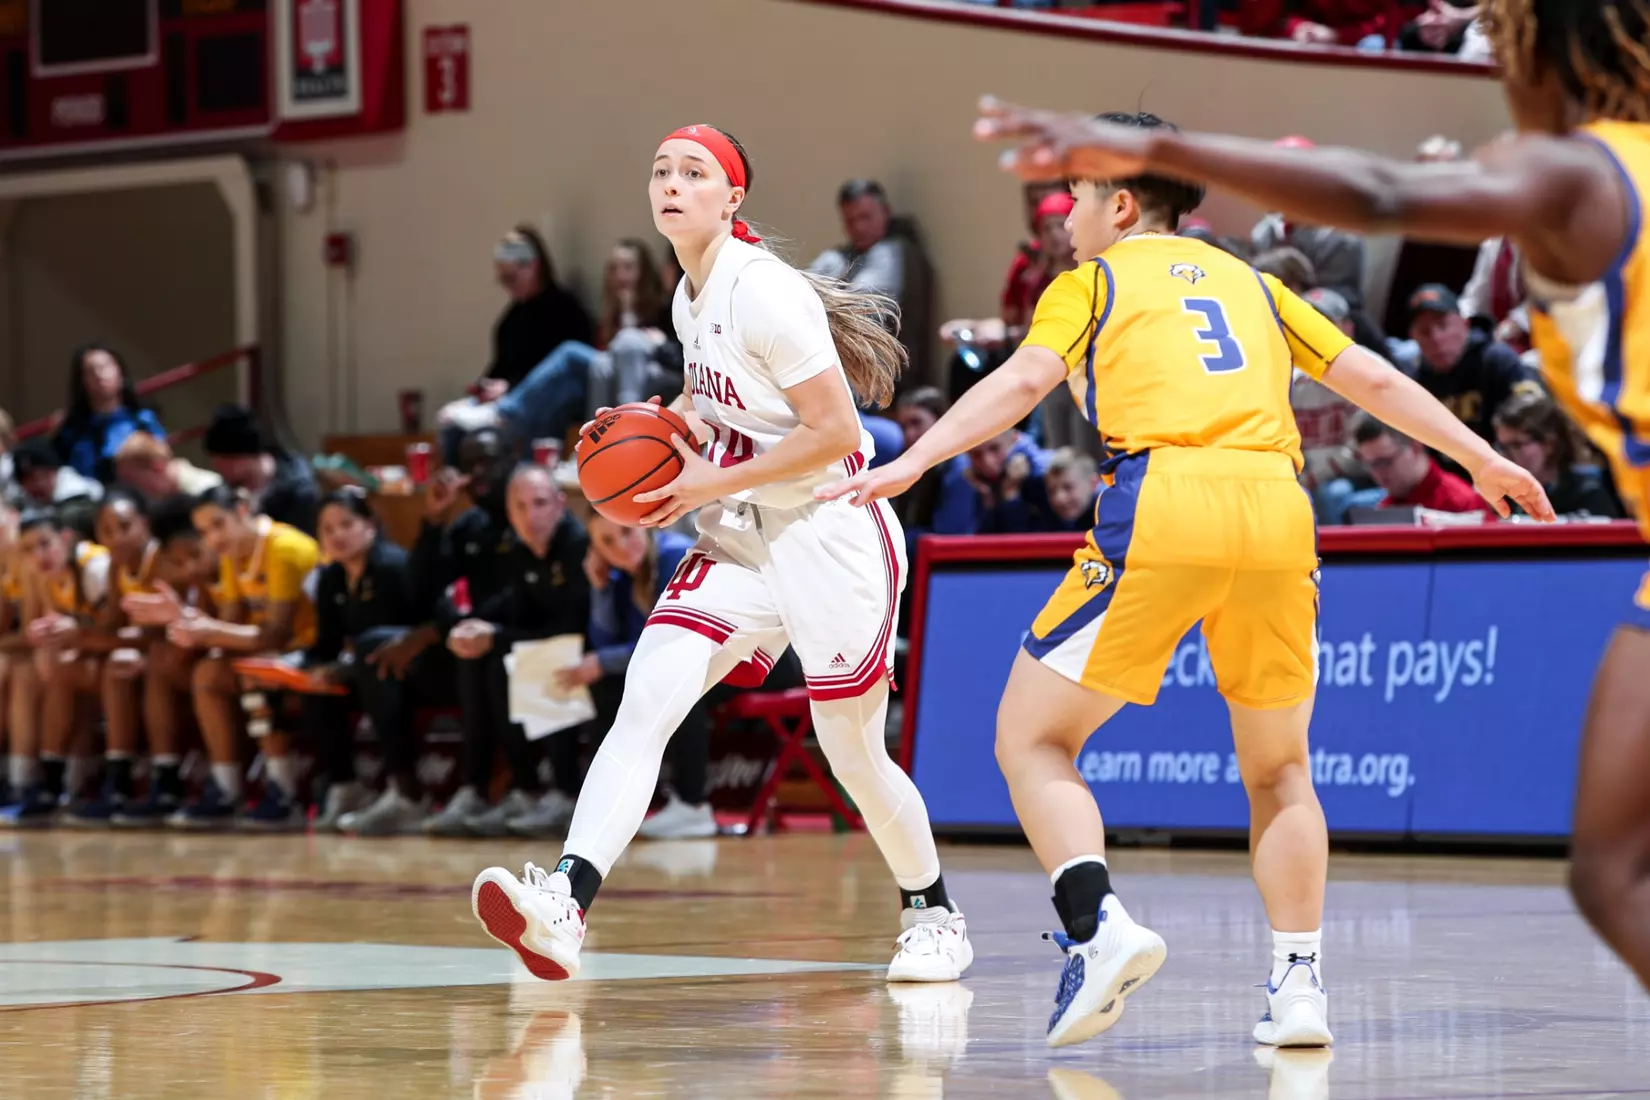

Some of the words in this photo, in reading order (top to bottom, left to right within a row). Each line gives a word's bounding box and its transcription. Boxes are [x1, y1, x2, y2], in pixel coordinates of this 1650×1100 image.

[1182, 298, 1246, 374] 3
[1384, 624, 1498, 704] pays!
[1080, 751, 1142, 783] earn
[1148, 751, 1221, 784] more
[1310, 746, 1416, 797] tra.org.
